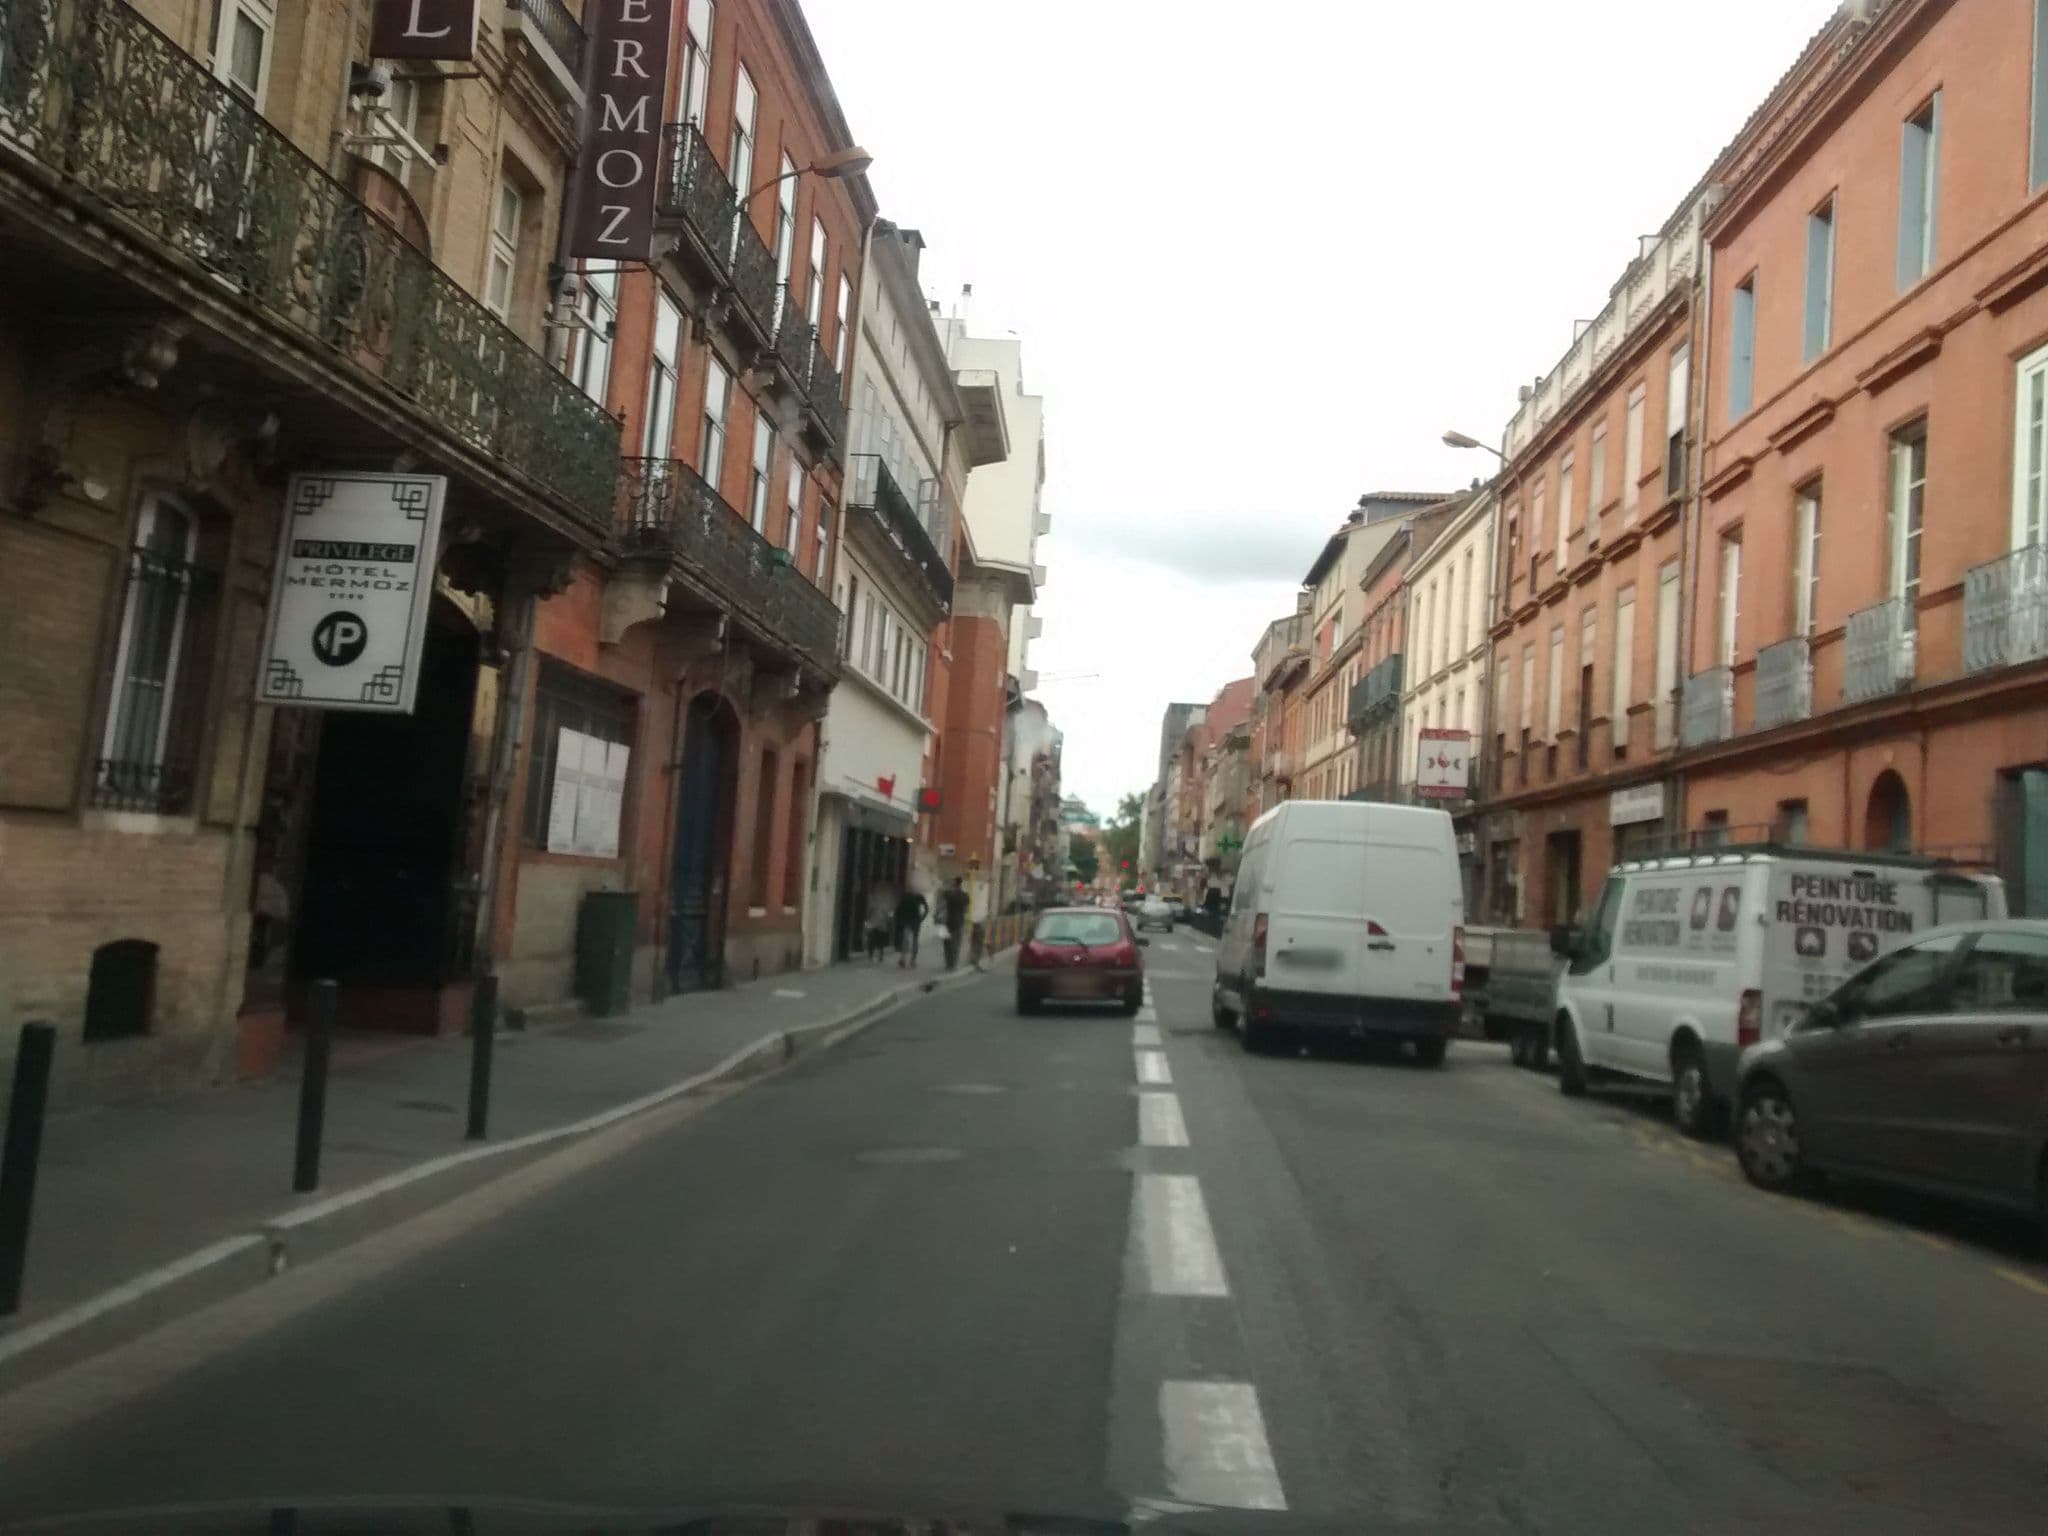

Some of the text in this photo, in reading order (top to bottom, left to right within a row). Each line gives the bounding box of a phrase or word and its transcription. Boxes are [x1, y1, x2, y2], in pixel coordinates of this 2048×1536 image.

[402, 0, 451, 38] L
[294, 541, 415, 562] PRIVILEGE
[286, 576, 409, 591] MERMOZ
[331, 621, 361, 656] P
[1791, 873, 1898, 905] PEINTURE
